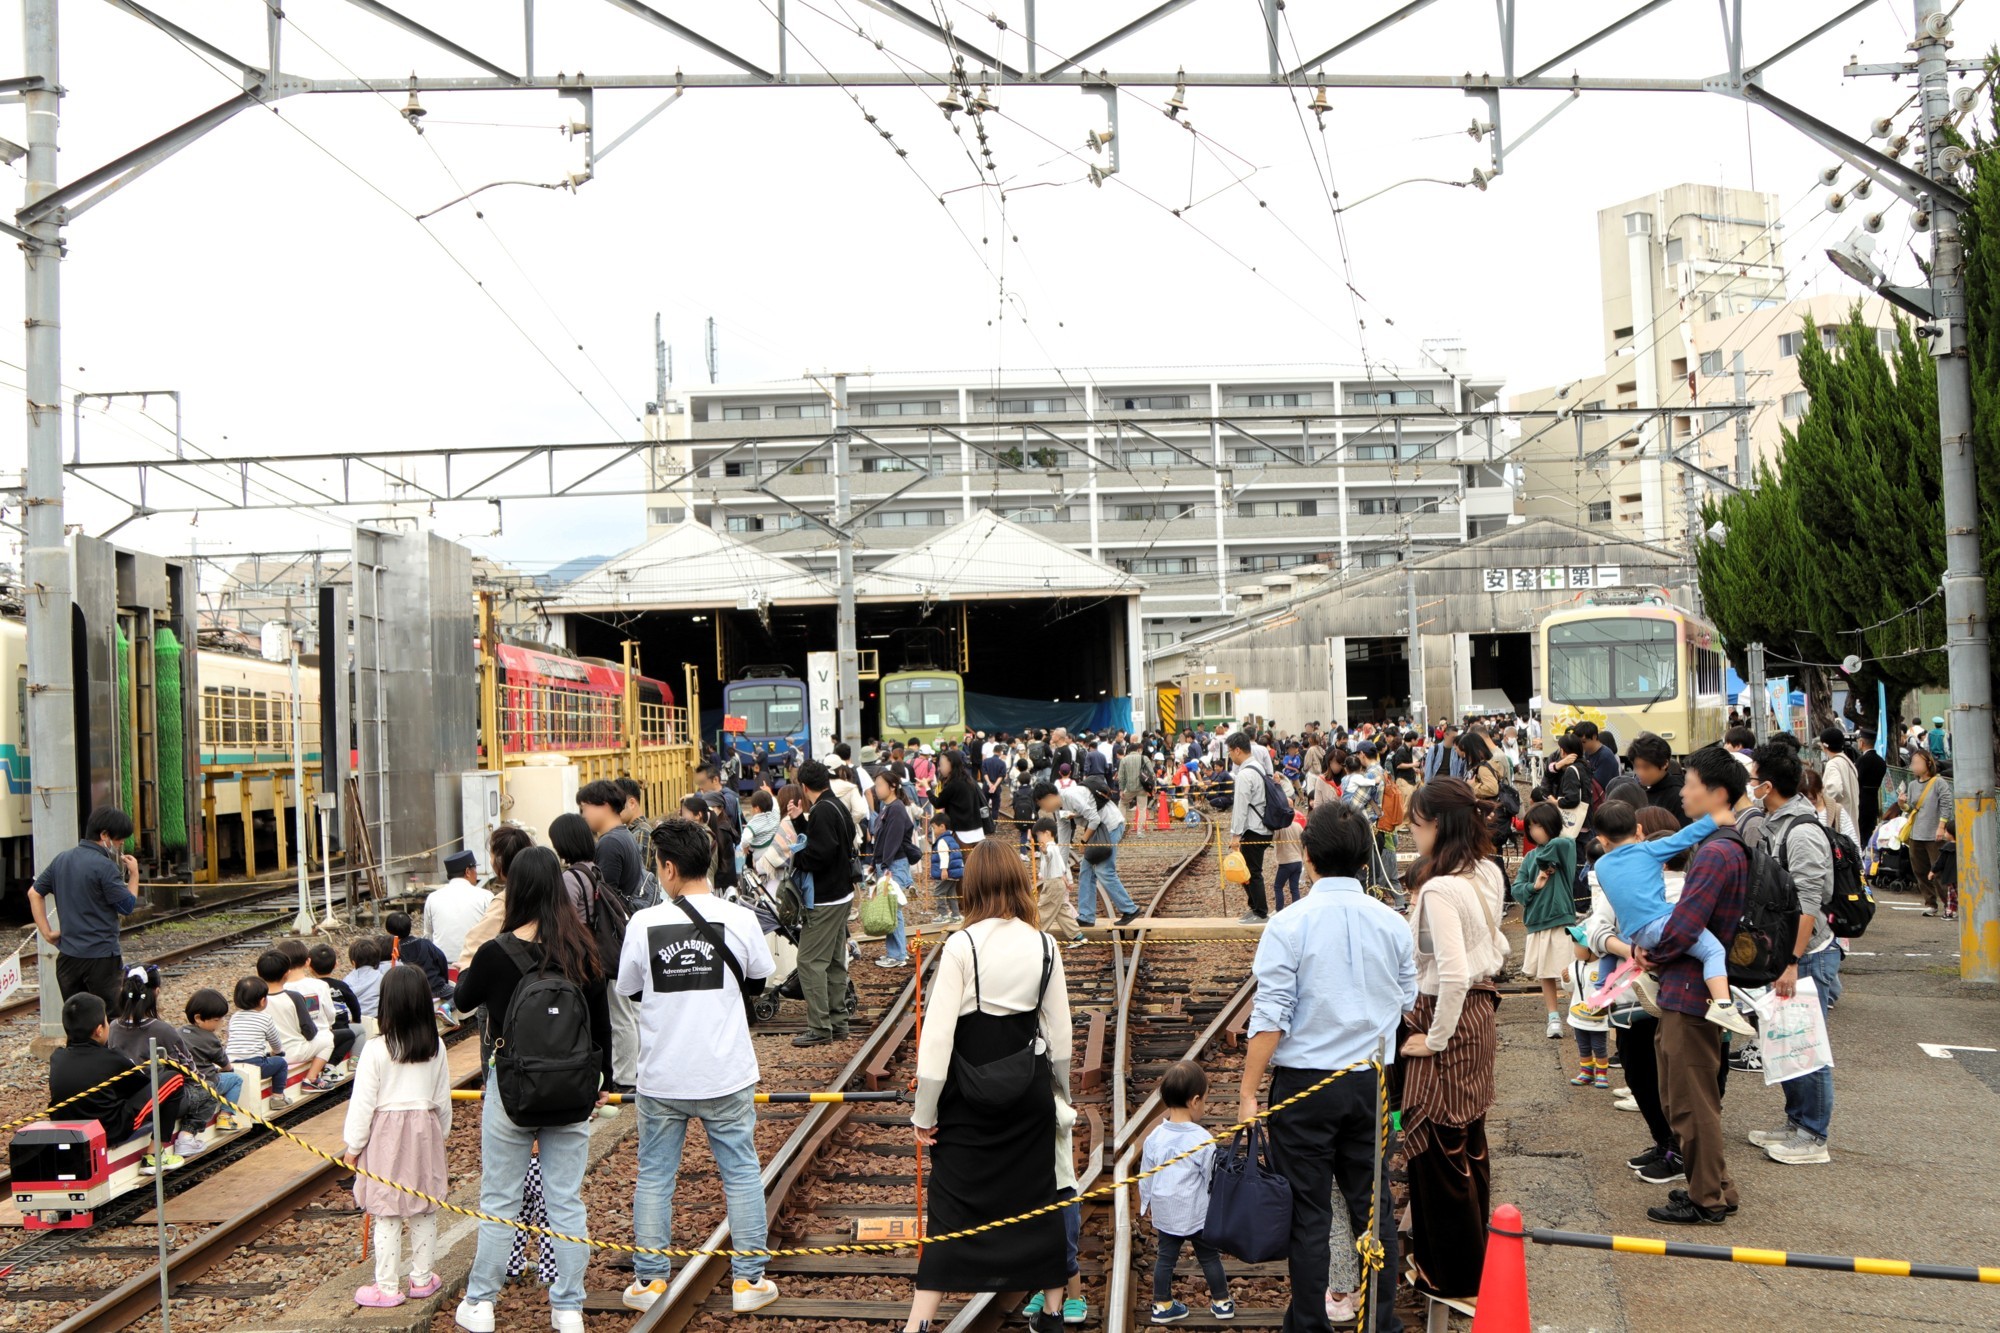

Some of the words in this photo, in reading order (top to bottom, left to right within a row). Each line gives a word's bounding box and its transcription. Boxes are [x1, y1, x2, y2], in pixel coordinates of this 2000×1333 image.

[1043, 579, 1051, 588] 4
[1486, 568, 1534, 589] 安全
[1571, 567, 1618, 586] 第一
[915, 583, 922, 592] 3
[626, 592, 631, 601] 1
[751, 589, 759, 600] 2
[817, 670, 831, 763] VR体
[658, 939, 715, 964] BILLABONG
